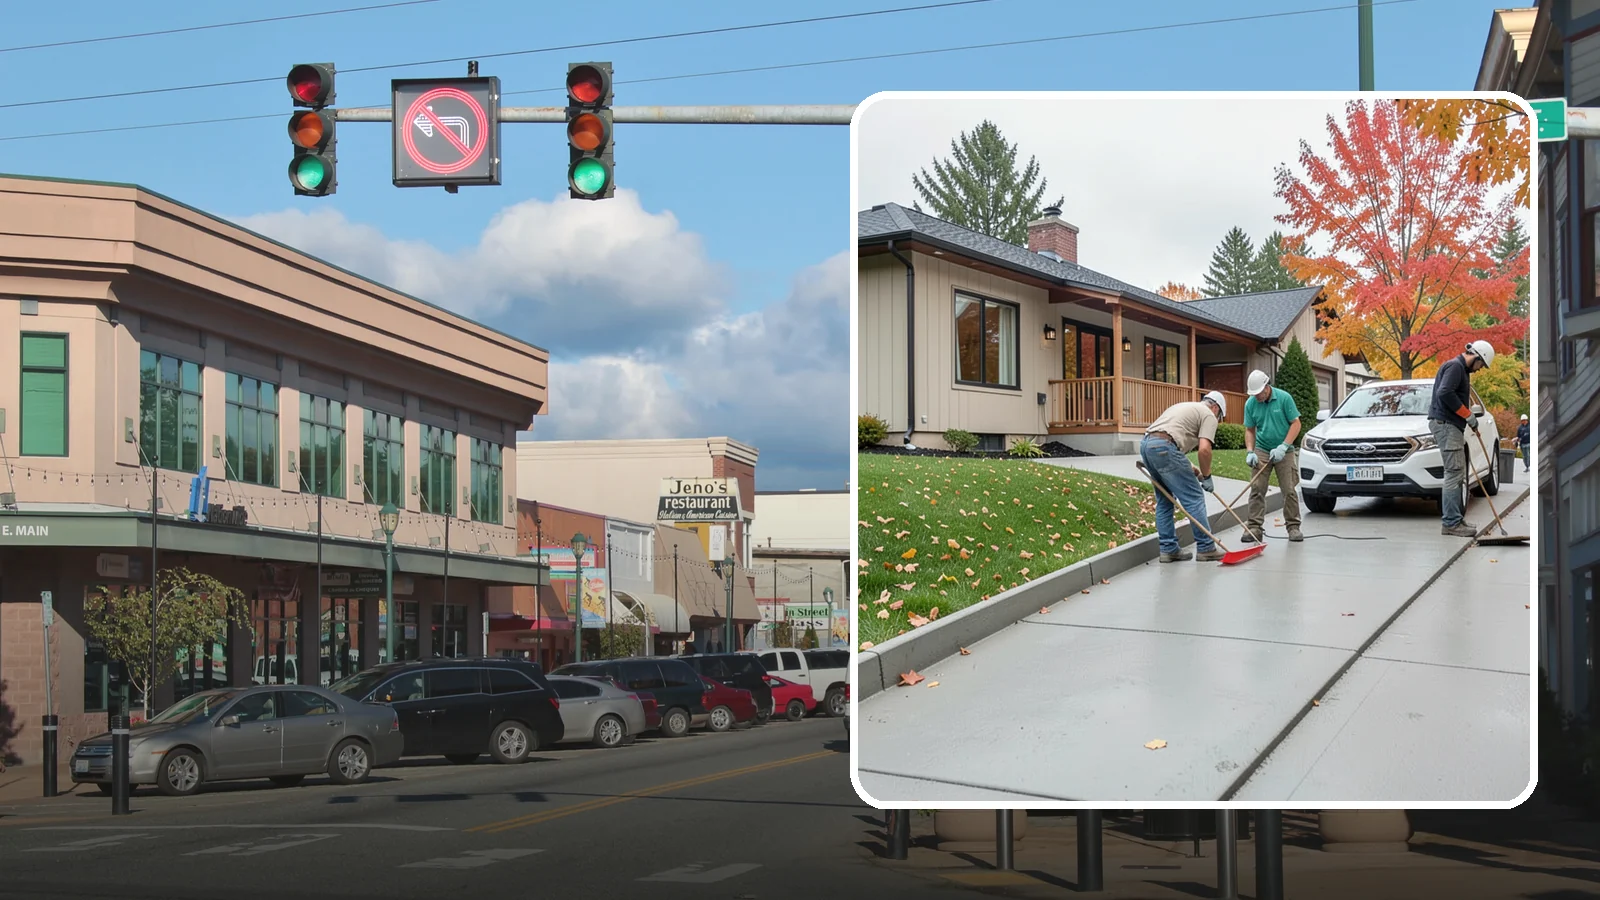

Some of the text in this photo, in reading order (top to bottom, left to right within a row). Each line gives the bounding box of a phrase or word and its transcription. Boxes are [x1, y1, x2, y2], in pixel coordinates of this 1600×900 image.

[669, 480, 727, 494] Jeno's
[665, 496, 731, 509] restaurant
[658, 510, 681, 519] Italian
[686, 510, 714, 519] American
[715, 509, 738, 519] Cuisine
[2, 525, 49, 536] E. MAIN
[797, 607, 828, 617] Street
